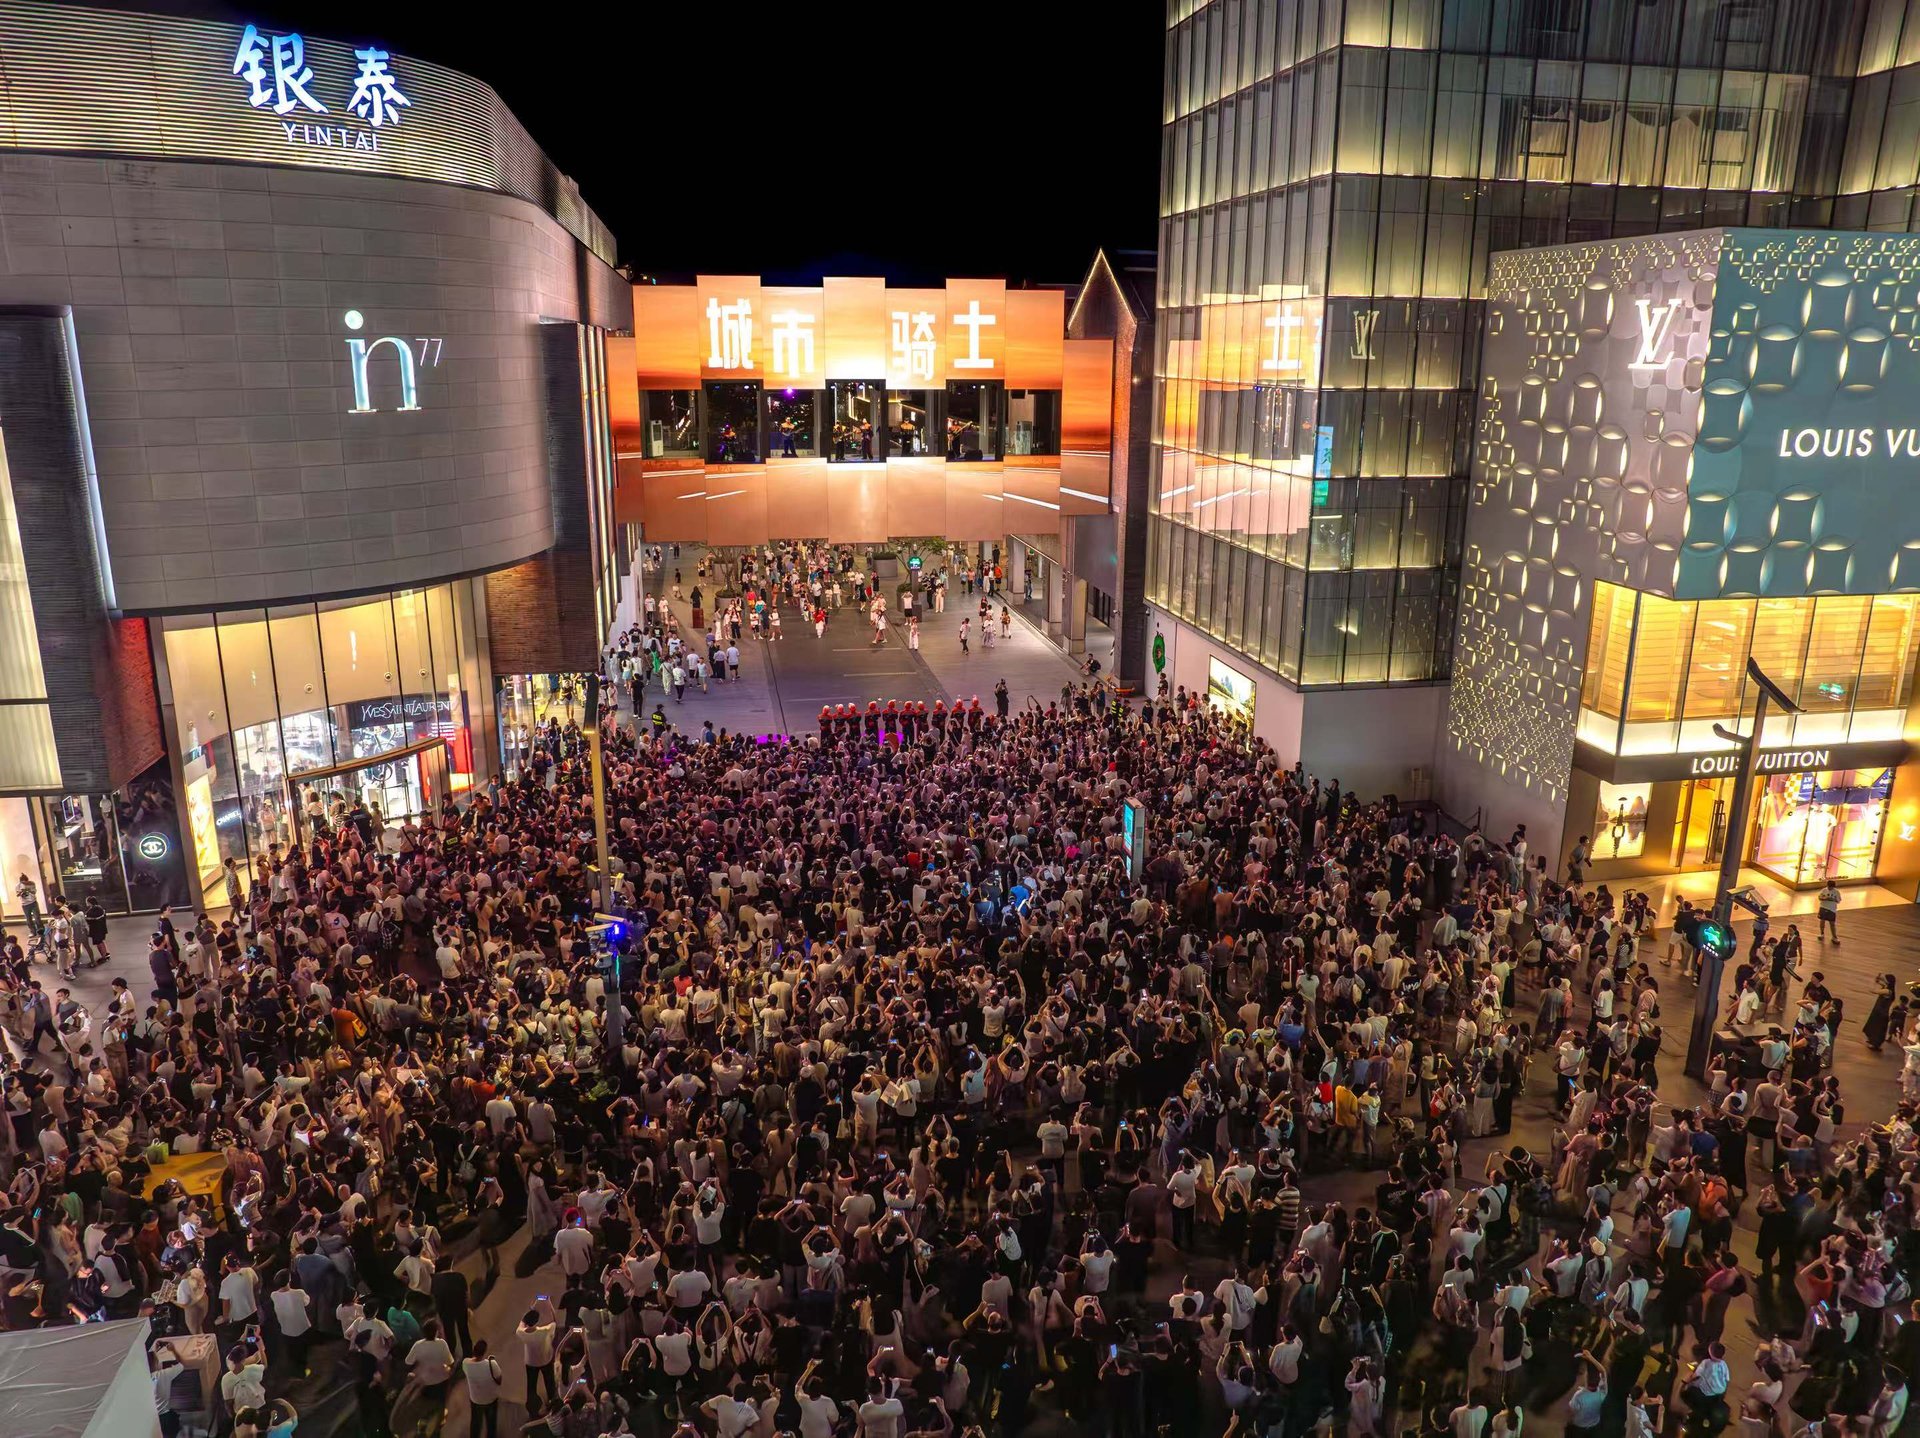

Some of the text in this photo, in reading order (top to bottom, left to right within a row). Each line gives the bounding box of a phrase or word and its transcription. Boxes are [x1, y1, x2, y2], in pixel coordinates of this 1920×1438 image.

[233, 24, 411, 127] 银泰
[281, 121, 378, 152] YINTAI
[1779, 428, 1875, 458] LOUIS
